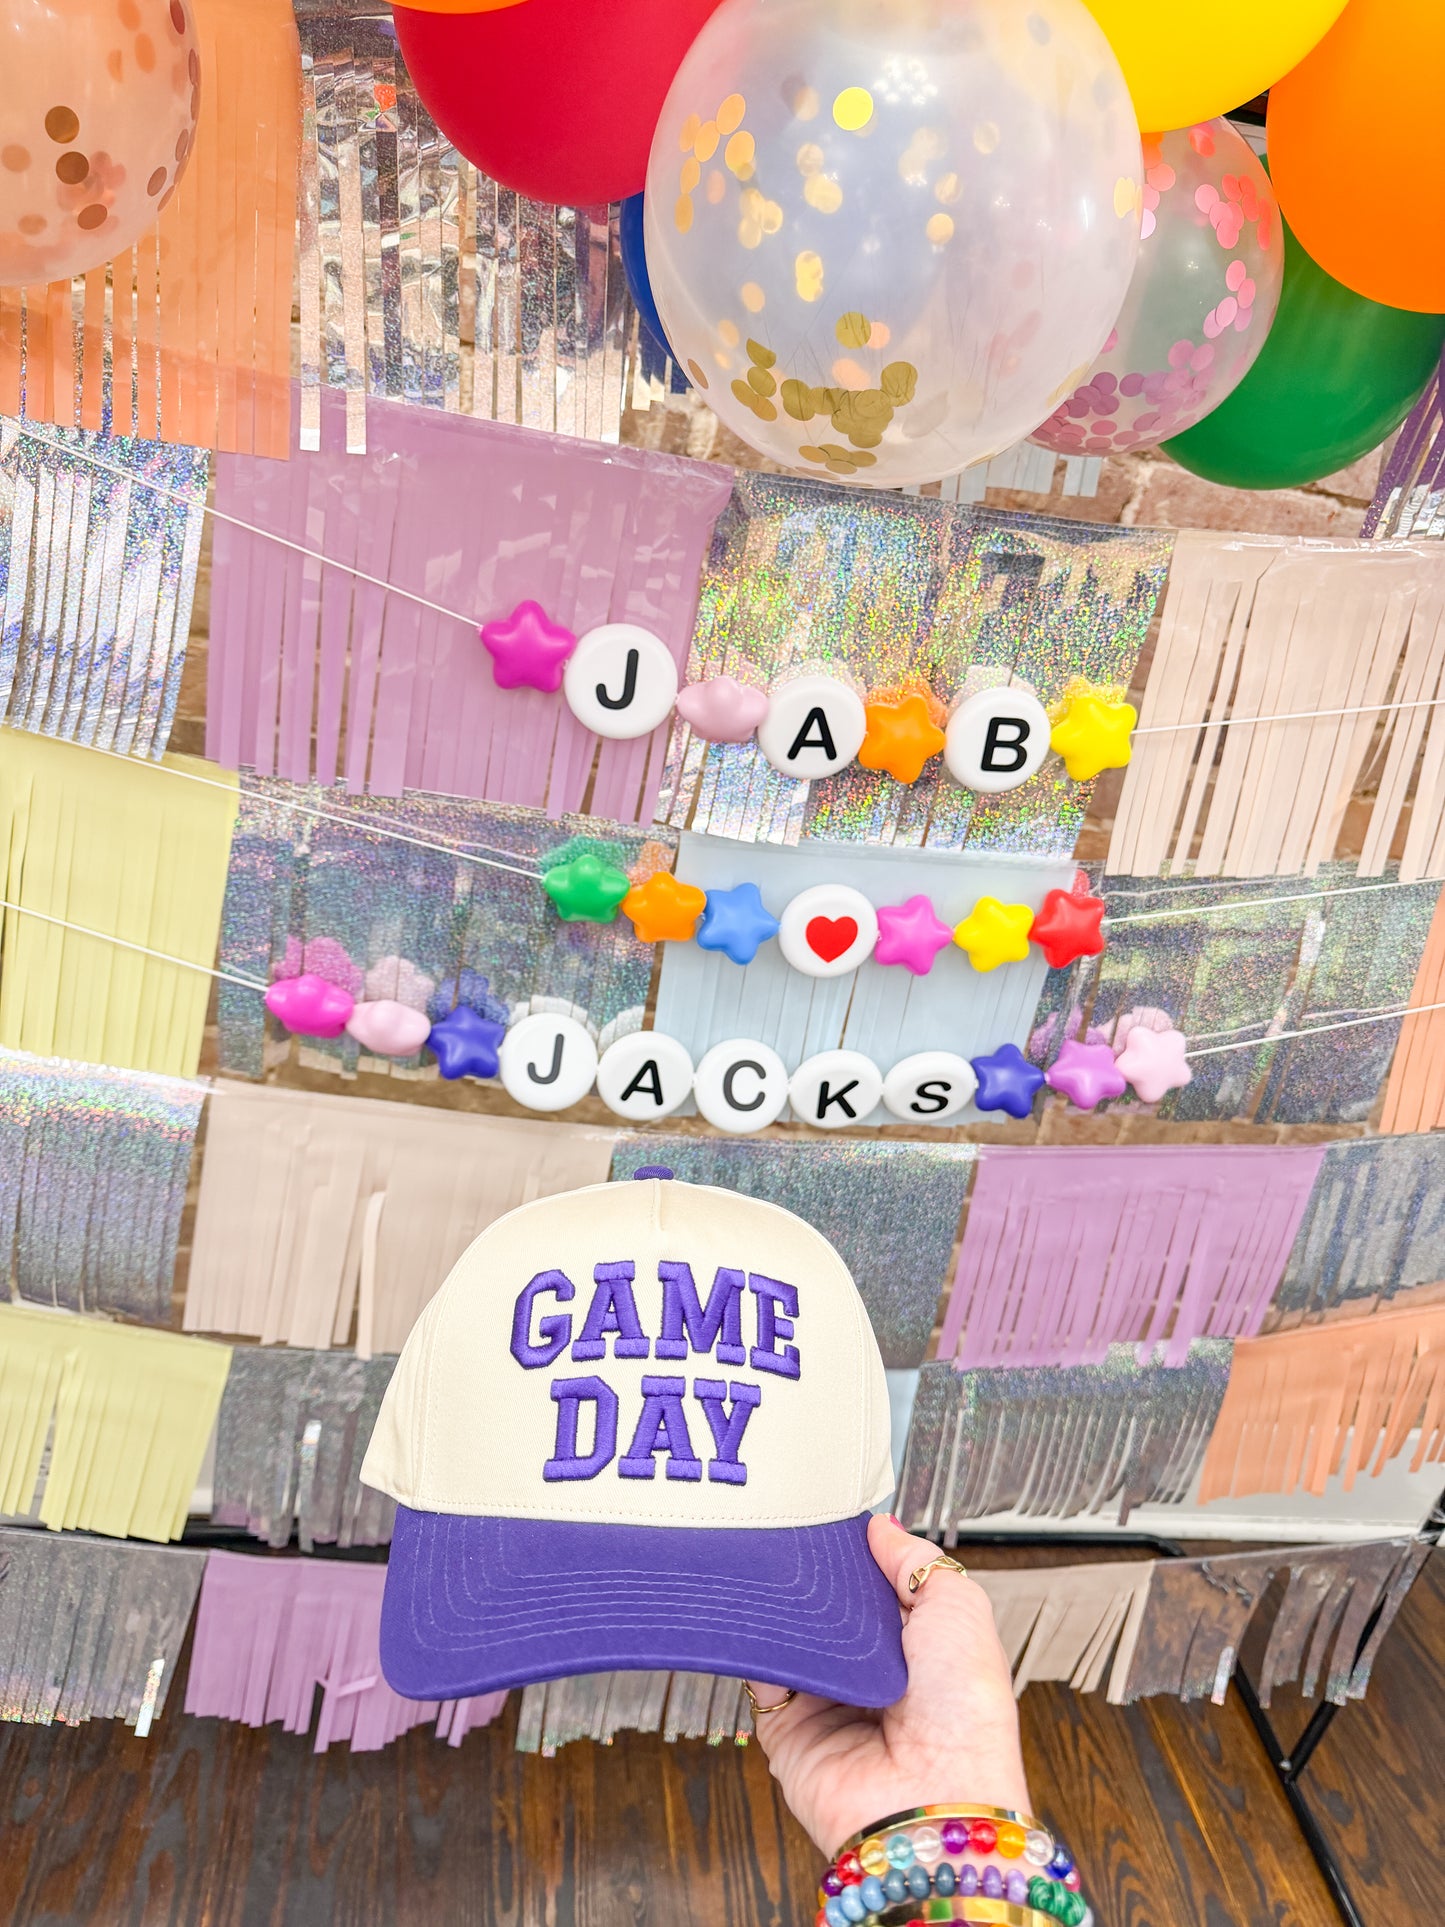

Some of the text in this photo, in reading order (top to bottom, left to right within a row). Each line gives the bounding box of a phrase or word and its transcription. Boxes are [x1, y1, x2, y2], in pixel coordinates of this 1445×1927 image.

[527, 1033, 953, 1121] JACKS
[509, 1259, 801, 1381] GAME
[542, 1374, 762, 1486] DAY
